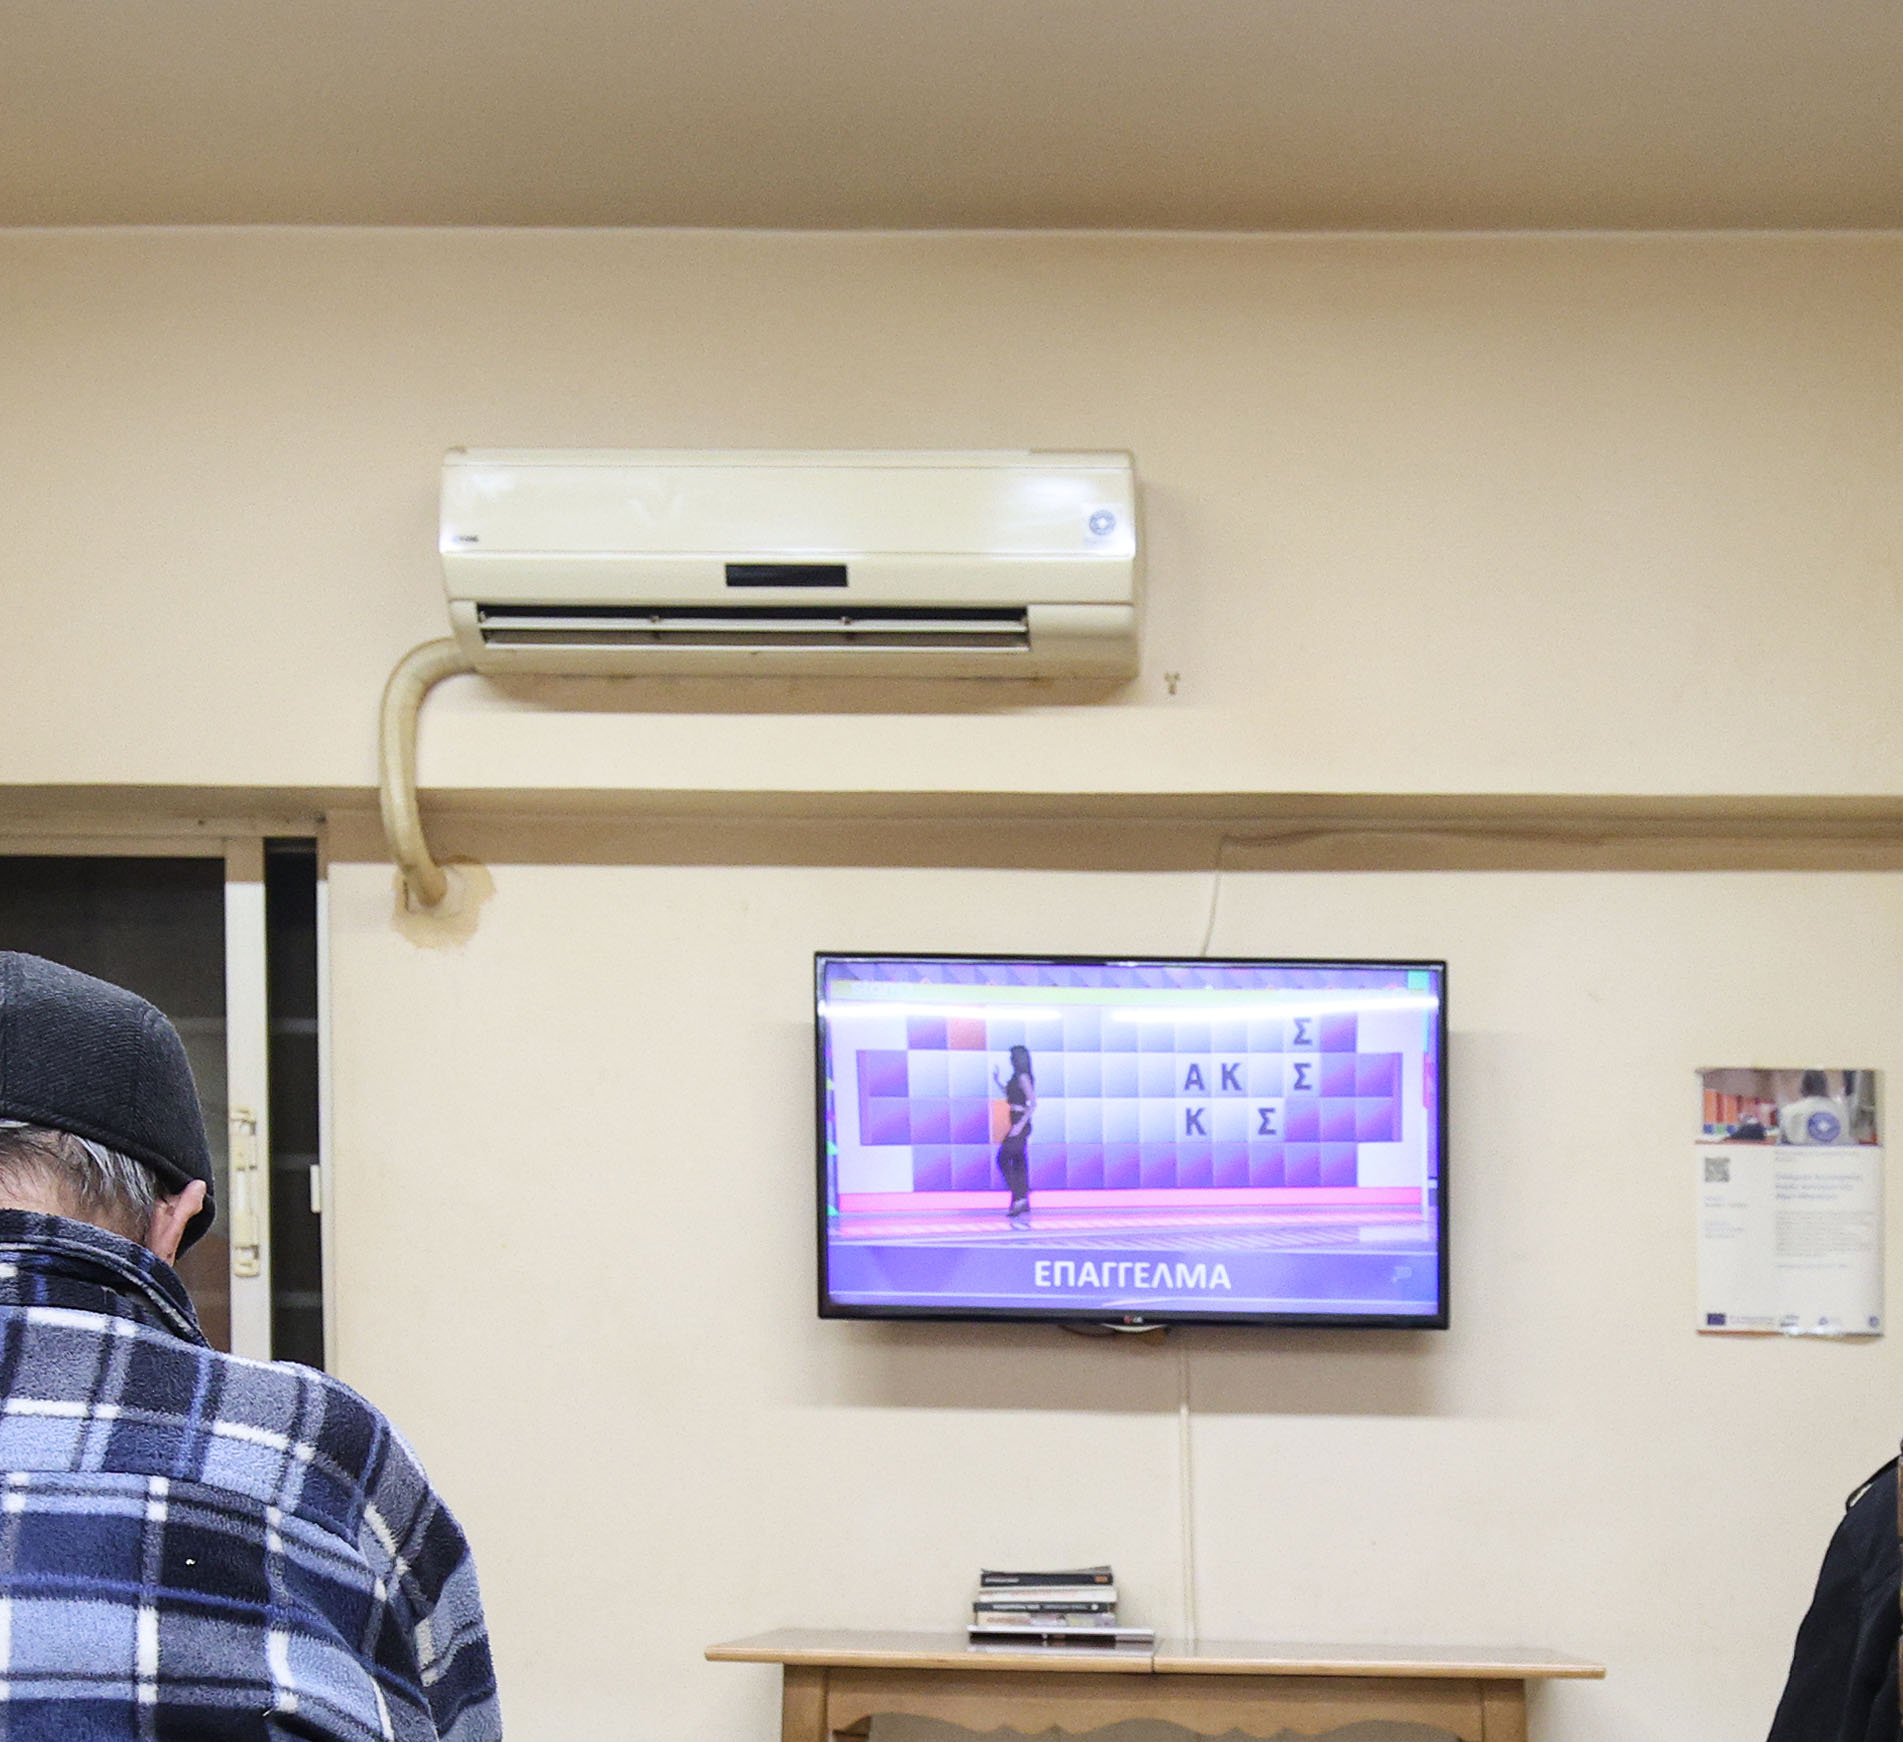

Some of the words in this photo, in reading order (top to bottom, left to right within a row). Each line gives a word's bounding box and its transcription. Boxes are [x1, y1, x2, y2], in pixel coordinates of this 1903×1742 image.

[1293, 1017, 1312, 1045] Σ
[1293, 1062, 1312, 1090] Σ
[1258, 1107, 1276, 1135] Σ
[1034, 1260, 1232, 1290] ΕΠΑΓΓΕΛΜΑ
